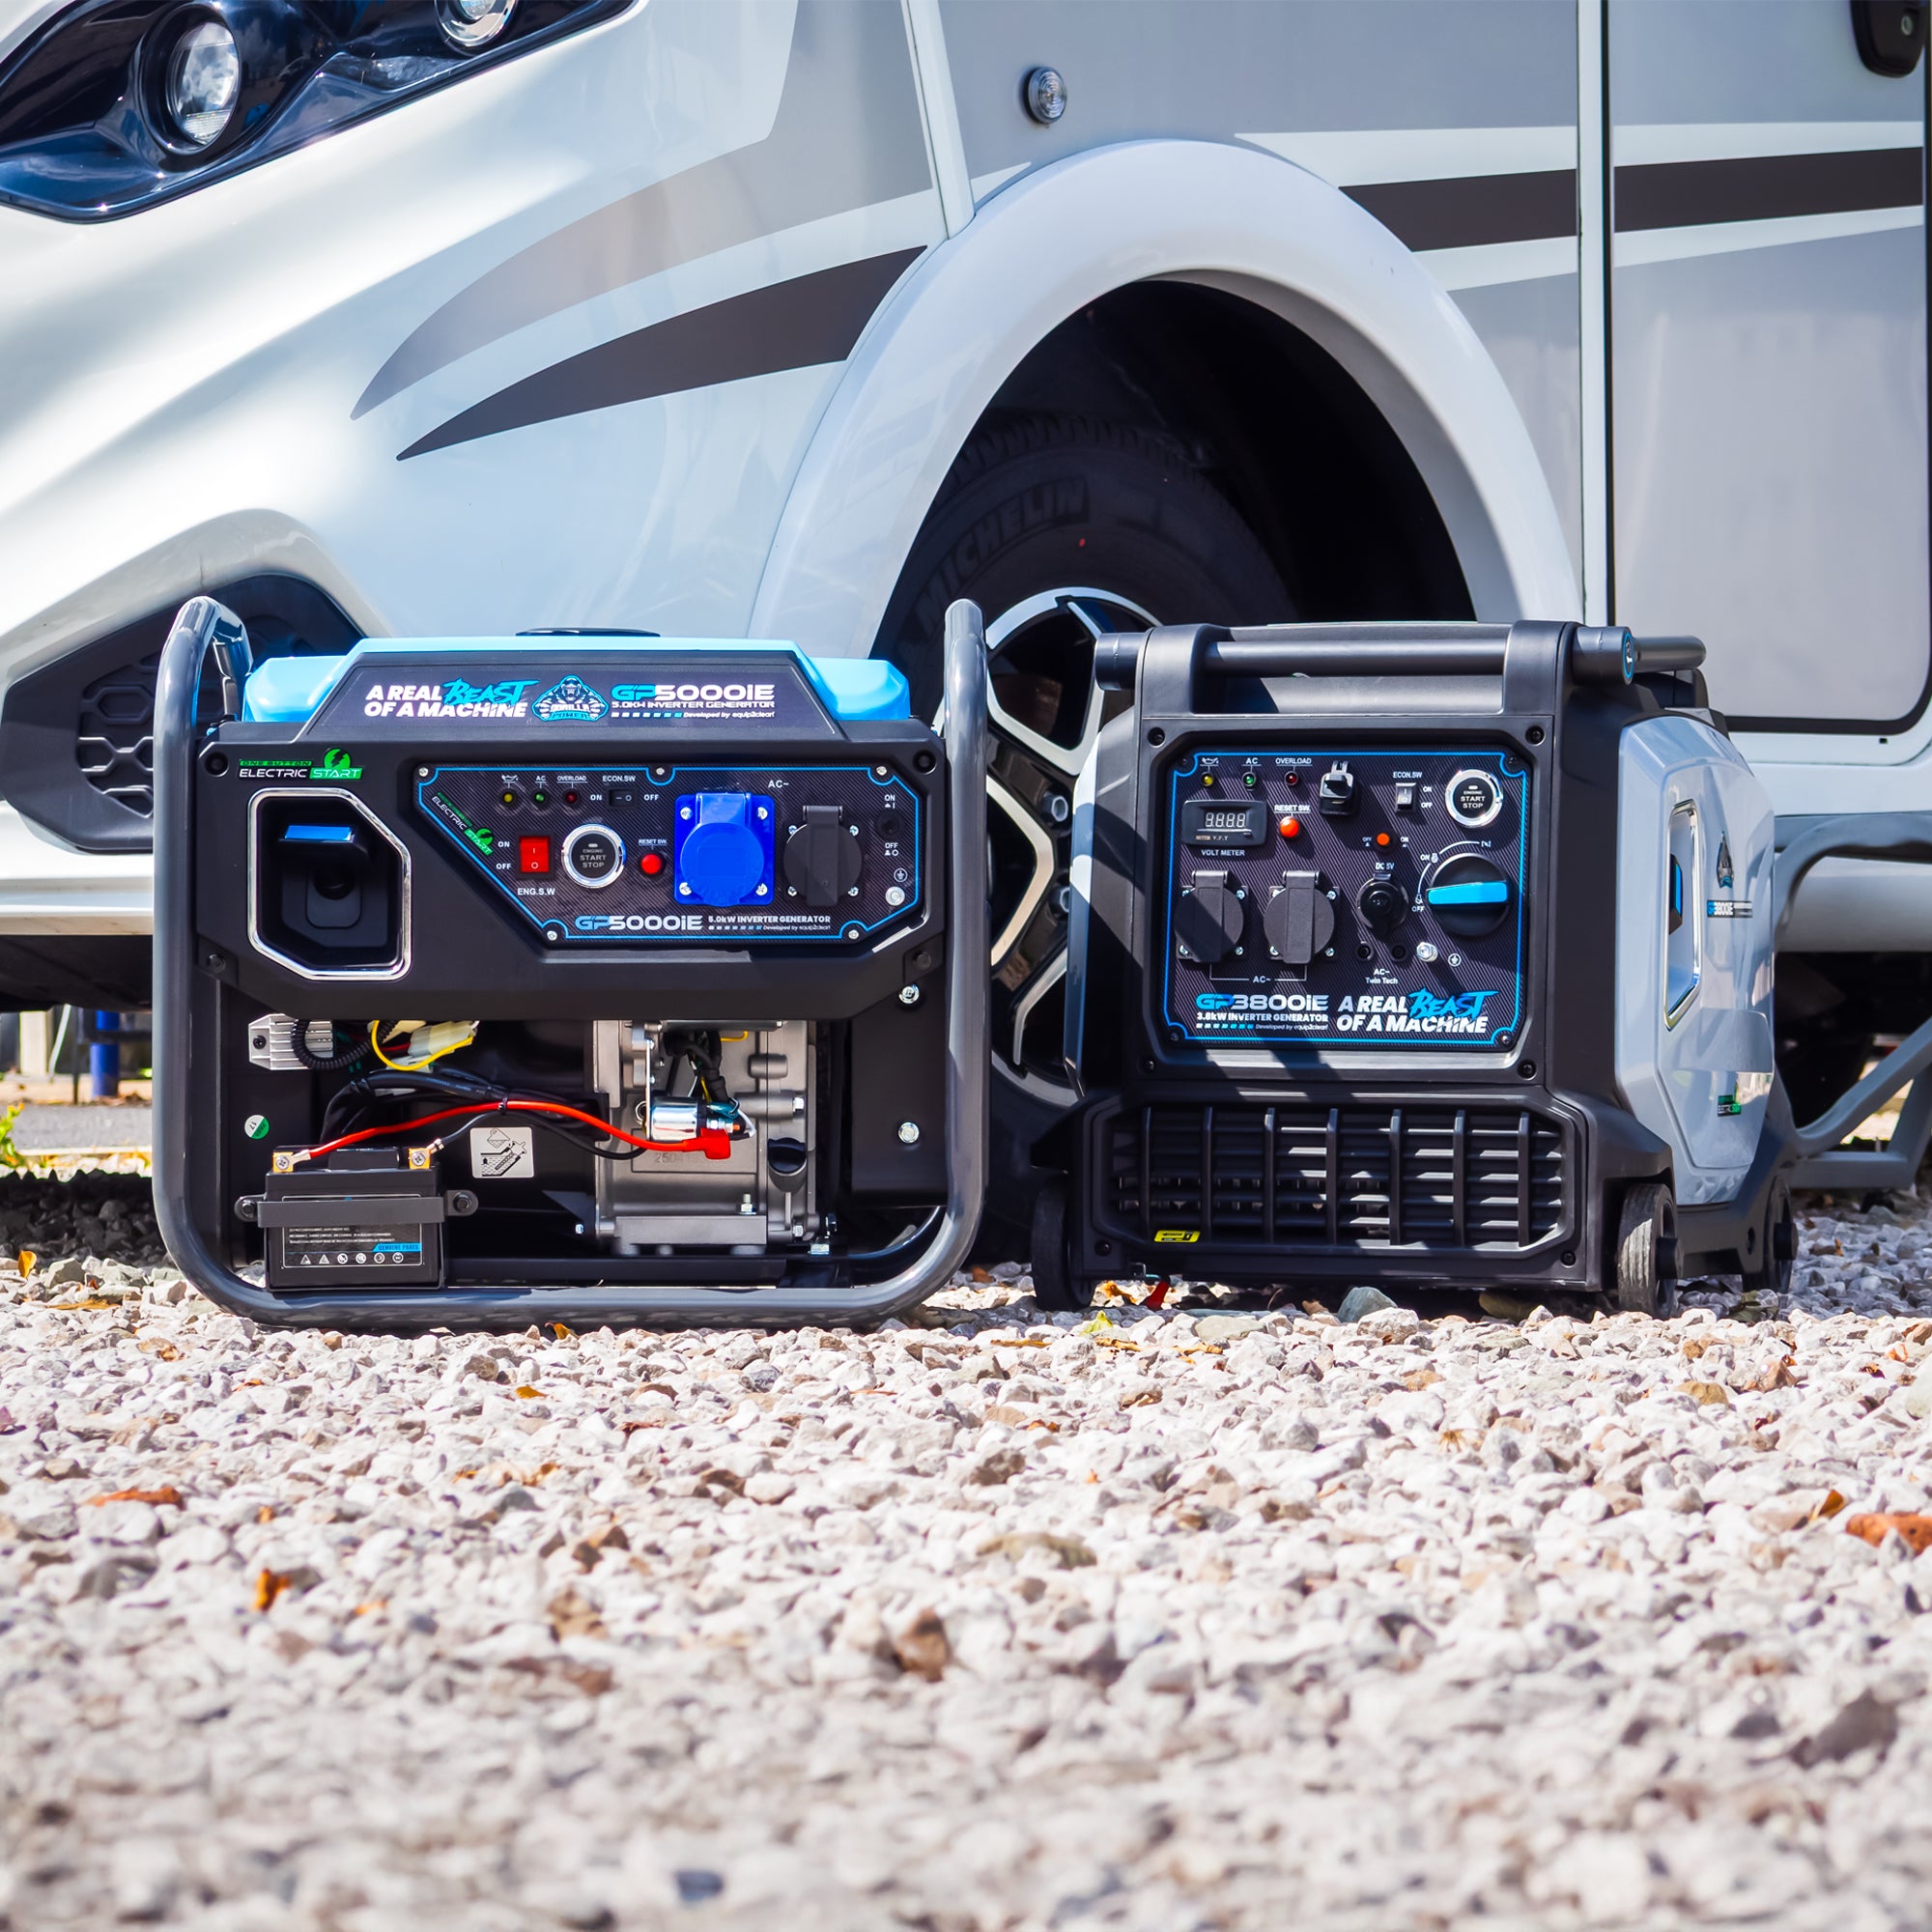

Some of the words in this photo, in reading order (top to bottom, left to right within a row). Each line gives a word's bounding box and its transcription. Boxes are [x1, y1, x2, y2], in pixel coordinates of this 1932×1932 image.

[916, 477, 1089, 639] MICHELIN
[365, 685, 384, 700] A
[386, 685, 442, 700] REAL
[442, 677, 540, 707] BEAST
[364, 702, 396, 717] OF
[396, 702, 415, 717] A
[417, 702, 528, 718] MACHINE
[683, 711, 721, 720] Developed
[721, 711, 731, 720] by
[240, 768, 308, 778] ELECTRIC
[313, 768, 361, 778] START
[431, 796, 468, 831] ELECTRIC
[465, 828, 493, 855] START
[737, 915, 779, 923] INVERTER
[779, 915, 831, 923] GENERATOR
[1338, 995, 1353, 1011] A
[1356, 995, 1408, 1013] REAL
[1407, 986, 1499, 1020] BEAST
[1228, 1012, 1272, 1022] INVERTER
[1273, 1013, 1329, 1023] GENERATOR
[1336, 1014, 1368, 1032] OF
[1366, 1014, 1383, 1032] A
[1385, 1014, 1489, 1034] MACHINE
